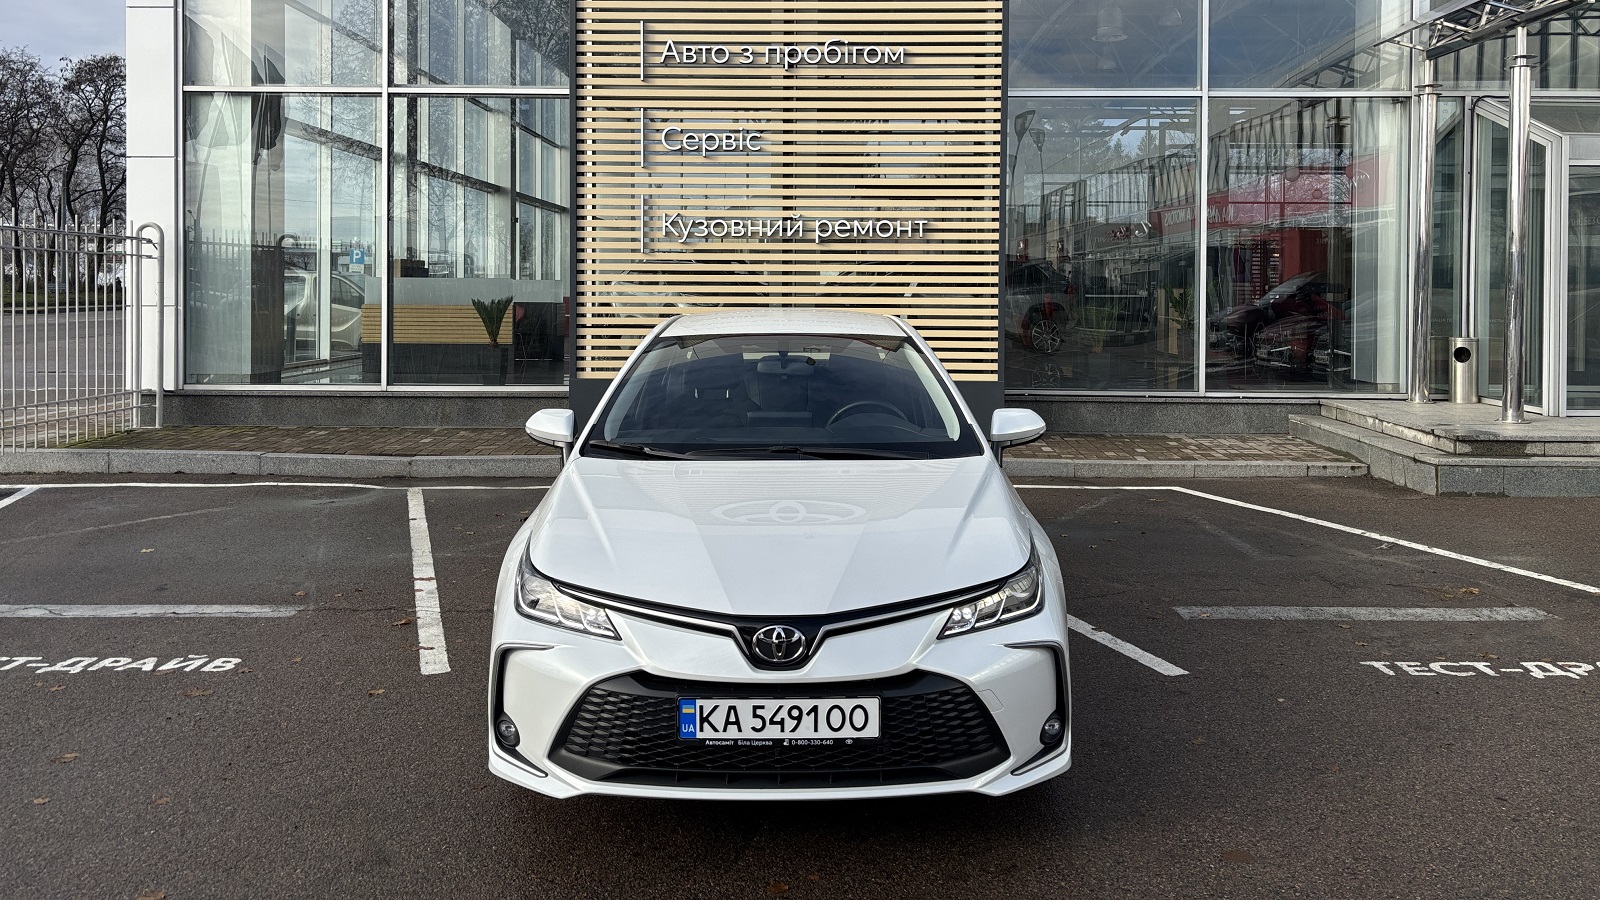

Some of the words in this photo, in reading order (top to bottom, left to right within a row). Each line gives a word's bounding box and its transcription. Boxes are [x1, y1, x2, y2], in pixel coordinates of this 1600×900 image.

[660, 39, 730, 65] Авто
[738, 47, 754, 64] з
[764, 38, 905, 71] пробігом
[661, 127, 762, 157] Сервіс
[661, 213, 804, 244] Кузовний
[815, 219, 928, 244] ремонт
[1360, 661, 1600, 680] ТЕСТ-ДР
[682, 724, 695, 733] UA
[699, 704, 743, 733] KA
[750, 704, 819, 733] 5491
